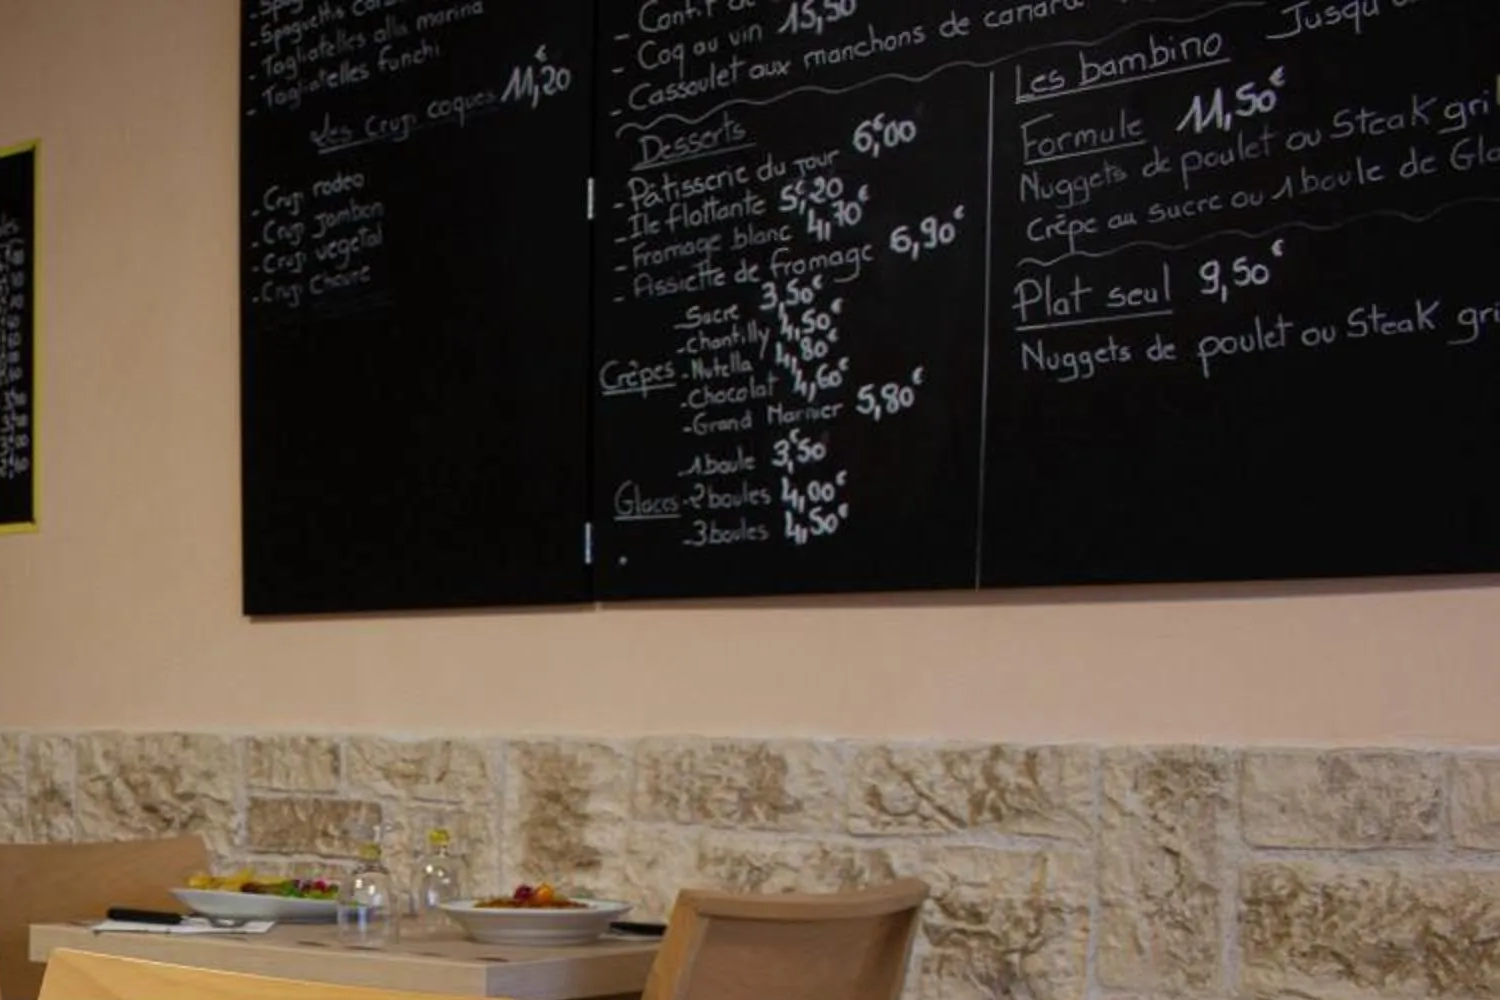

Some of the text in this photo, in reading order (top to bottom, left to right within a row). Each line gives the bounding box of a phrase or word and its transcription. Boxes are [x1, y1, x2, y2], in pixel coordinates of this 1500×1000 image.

[416, 1, 484, 32] marina
[628, 54, 745, 110] Cassoulet
[749, 59, 791, 79] aux
[804, 22, 926, 69] manchons
[939, 10, 970, 38] de
[638, 40, 684, 79] Coq
[729, 24, 763, 46] vin
[1014, 32, 1224, 102] Les bambino
[639, 110, 747, 163] Desserts
[1020, 109, 1145, 160] Formule
[756, 153, 786, 180] du
[1020, 160, 1128, 209] Nuggets
[1142, 147, 1172, 178] de
[1181, 129, 1276, 190] poulet
[1285, 126, 1322, 150] ou
[1108, 211, 1137, 230] au
[1147, 191, 1225, 223] sucre
[1231, 187, 1264, 207] ou
[1300, 156, 1385, 194] boule
[1399, 146, 1436, 179] de
[668, 190, 766, 234] flottante
[730, 222, 794, 251] blanc
[633, 258, 726, 299] Assiette
[734, 266, 760, 284] de
[770, 245, 874, 284] fromage
[1013, 275, 1093, 323] Plat
[1107, 262, 1171, 307] seul
[691, 350, 753, 379] Nutella
[1022, 335, 1131, 384] Nuggets
[1146, 334, 1176, 361] de
[1199, 315, 1293, 379] poulet
[1301, 318, 1337, 345] ou
[693, 406, 752, 434] Grand
[767, 402, 843, 425] Marnier
